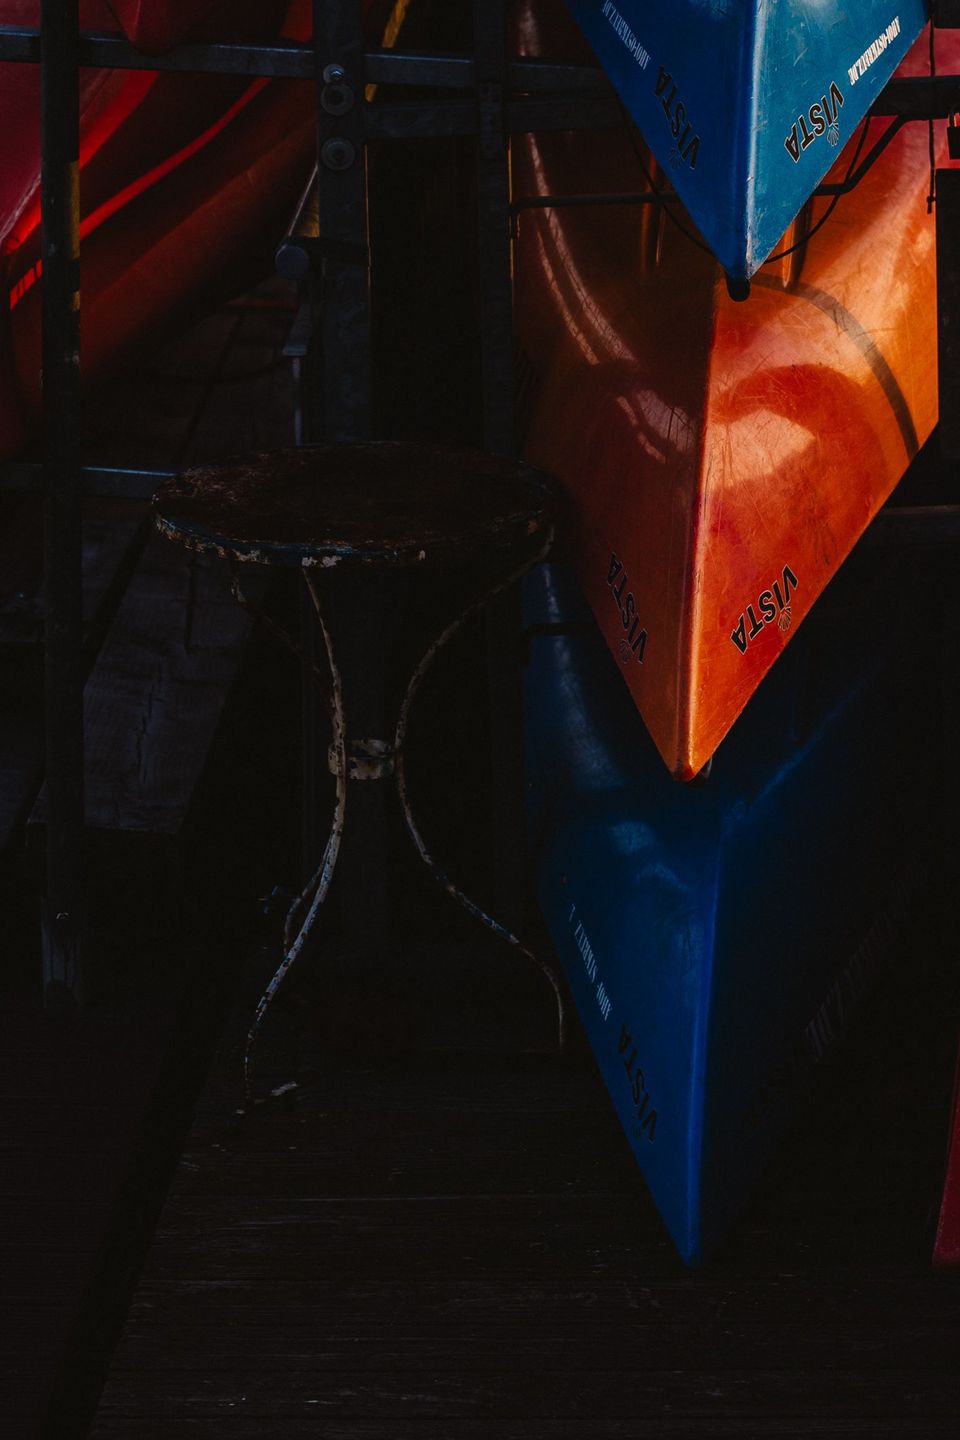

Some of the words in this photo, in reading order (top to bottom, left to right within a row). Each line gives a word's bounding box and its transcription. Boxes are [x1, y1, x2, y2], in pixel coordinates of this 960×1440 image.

[783, 81, 845, 164] VISTA
[606, 551, 648, 664] VISTA
[730, 563, 799, 655] VISTA
